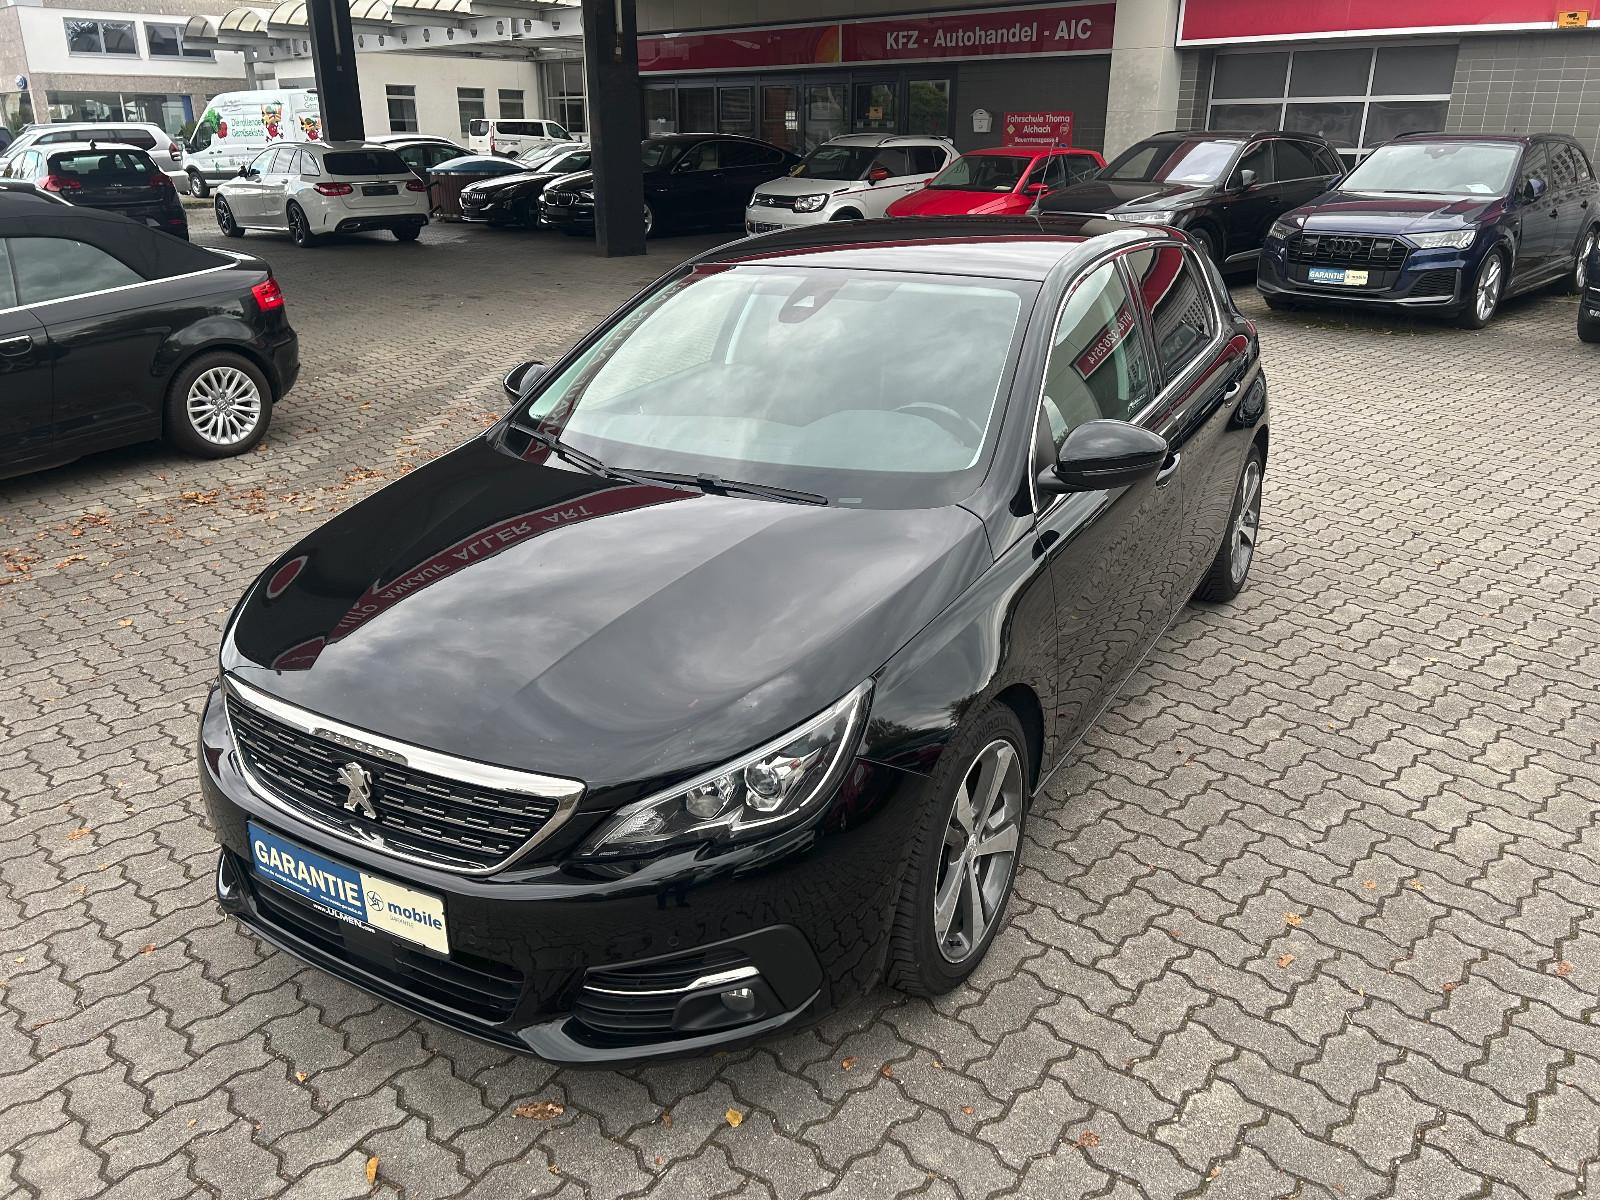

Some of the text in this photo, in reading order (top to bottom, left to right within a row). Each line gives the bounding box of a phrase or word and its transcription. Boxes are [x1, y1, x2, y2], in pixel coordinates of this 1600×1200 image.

[886, 30, 919, 50] KFZ
[933, 22, 1038, 48] Autohandel
[1054, 18, 1092, 40] AIC
[1007, 113, 1070, 123] Fahrschule Thoma
[1022, 124, 1051, 133] Aichach
[1310, 271, 1345, 280] GARANTIE
[254, 839, 362, 907] GARANTIE
[387, 902, 443, 930] mobile
